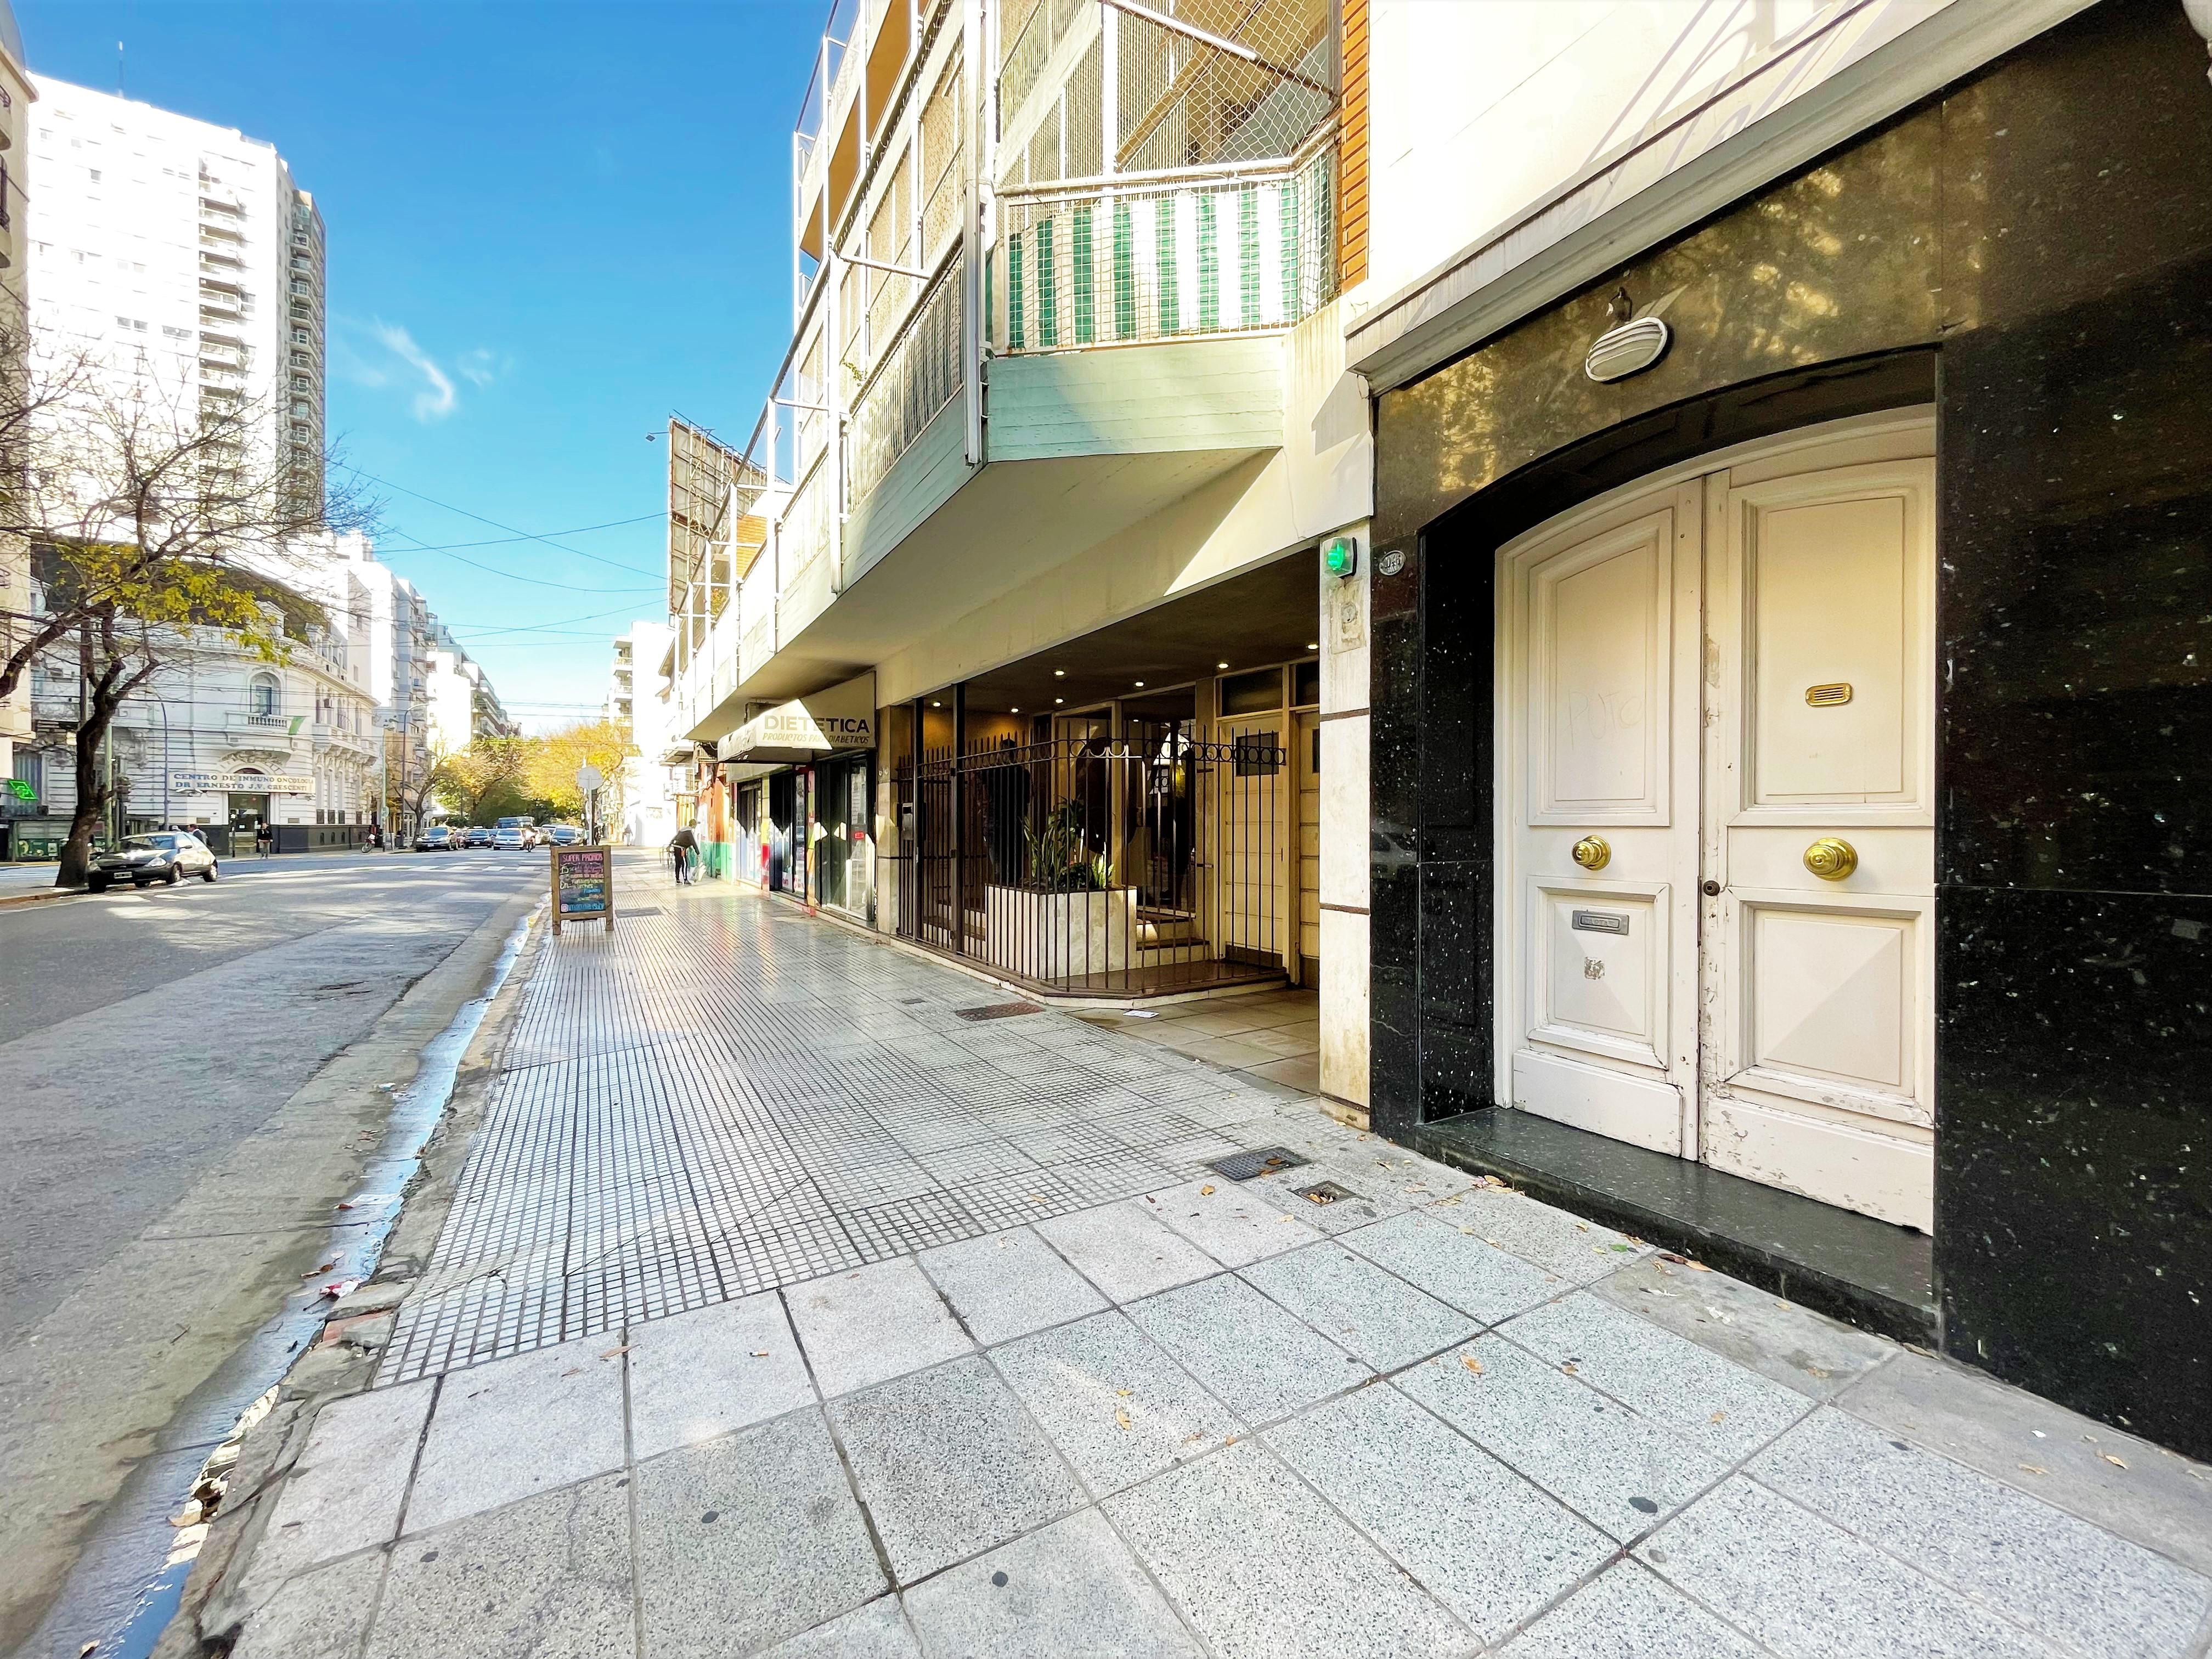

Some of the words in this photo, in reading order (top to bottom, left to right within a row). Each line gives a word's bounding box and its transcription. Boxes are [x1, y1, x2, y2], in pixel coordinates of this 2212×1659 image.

[764, 715, 870, 733] DIETETICA
[763, 732, 807, 742] PRODUCTOS
[828, 735, 870, 744] DIABETICOS
